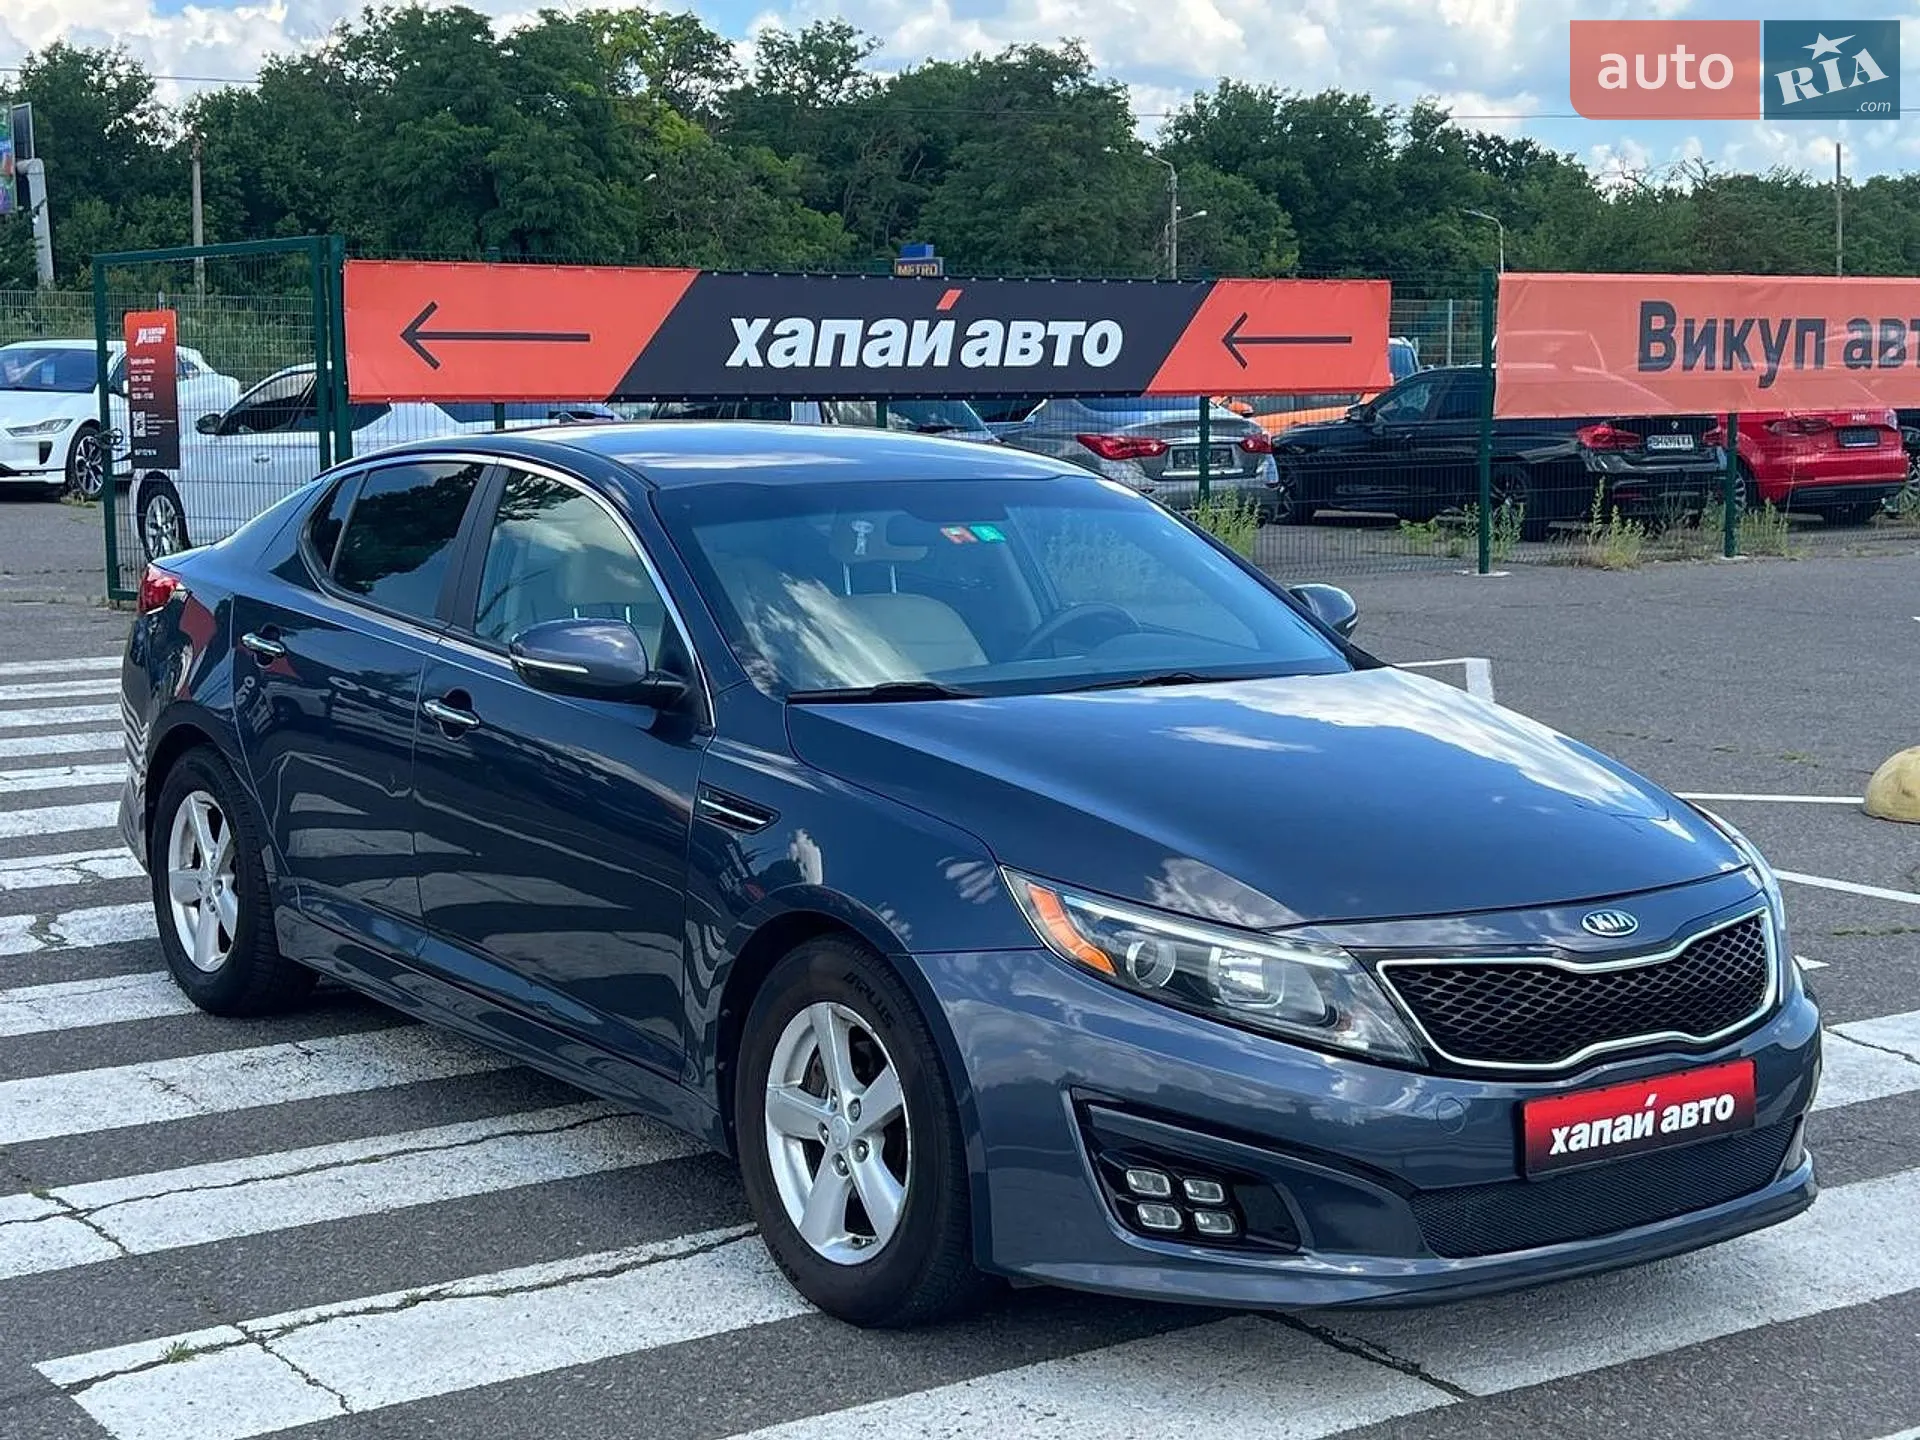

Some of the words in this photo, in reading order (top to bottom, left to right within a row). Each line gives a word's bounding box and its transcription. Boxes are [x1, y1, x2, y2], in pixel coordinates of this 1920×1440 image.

[725, 289, 962, 368] хапай
[960, 319, 1123, 368] авто
[1638, 300, 1827, 388] Викуп
[1549, 1093, 1657, 1155] хапай
[1660, 1093, 1735, 1133] авто
